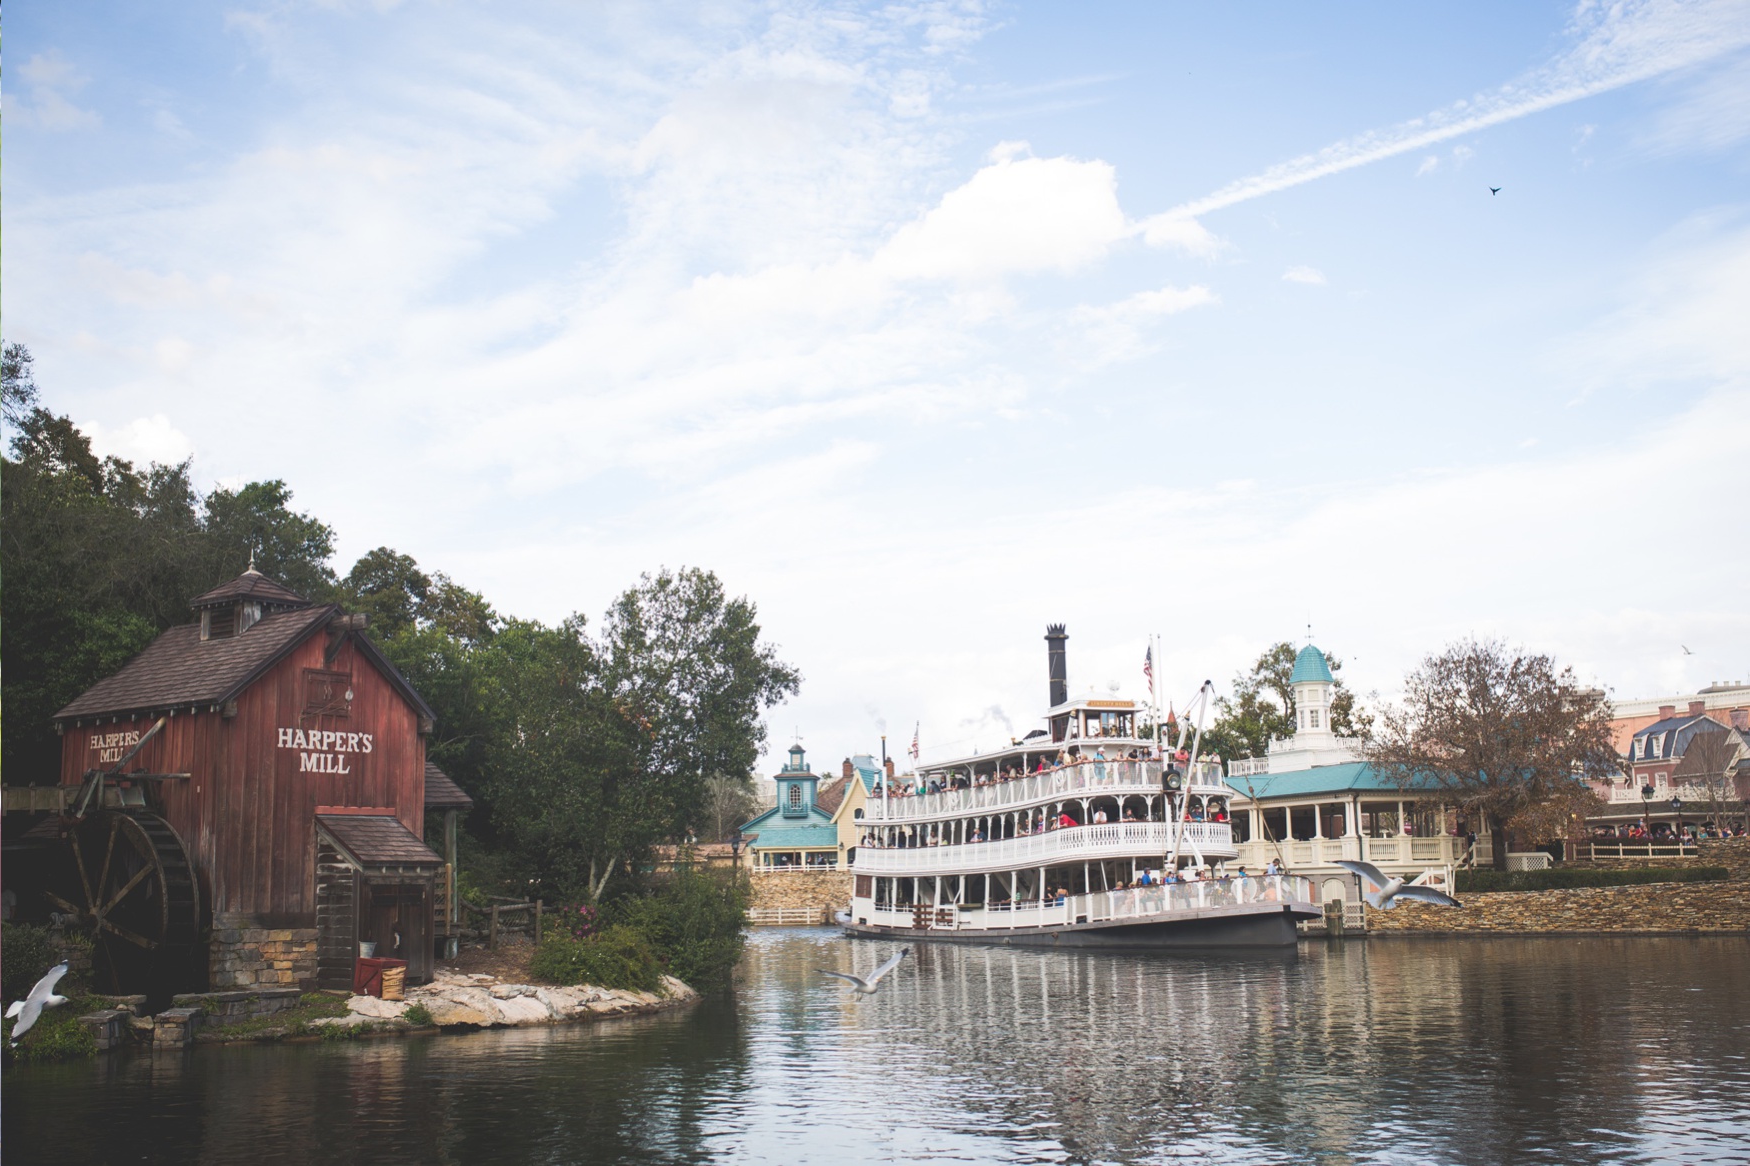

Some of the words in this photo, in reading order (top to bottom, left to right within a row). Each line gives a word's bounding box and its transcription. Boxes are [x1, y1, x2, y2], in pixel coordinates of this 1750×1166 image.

[90, 730, 140, 749] HARPER'S
[278, 728, 373, 753] HARPER'S
[300, 752, 350, 774] MILL
